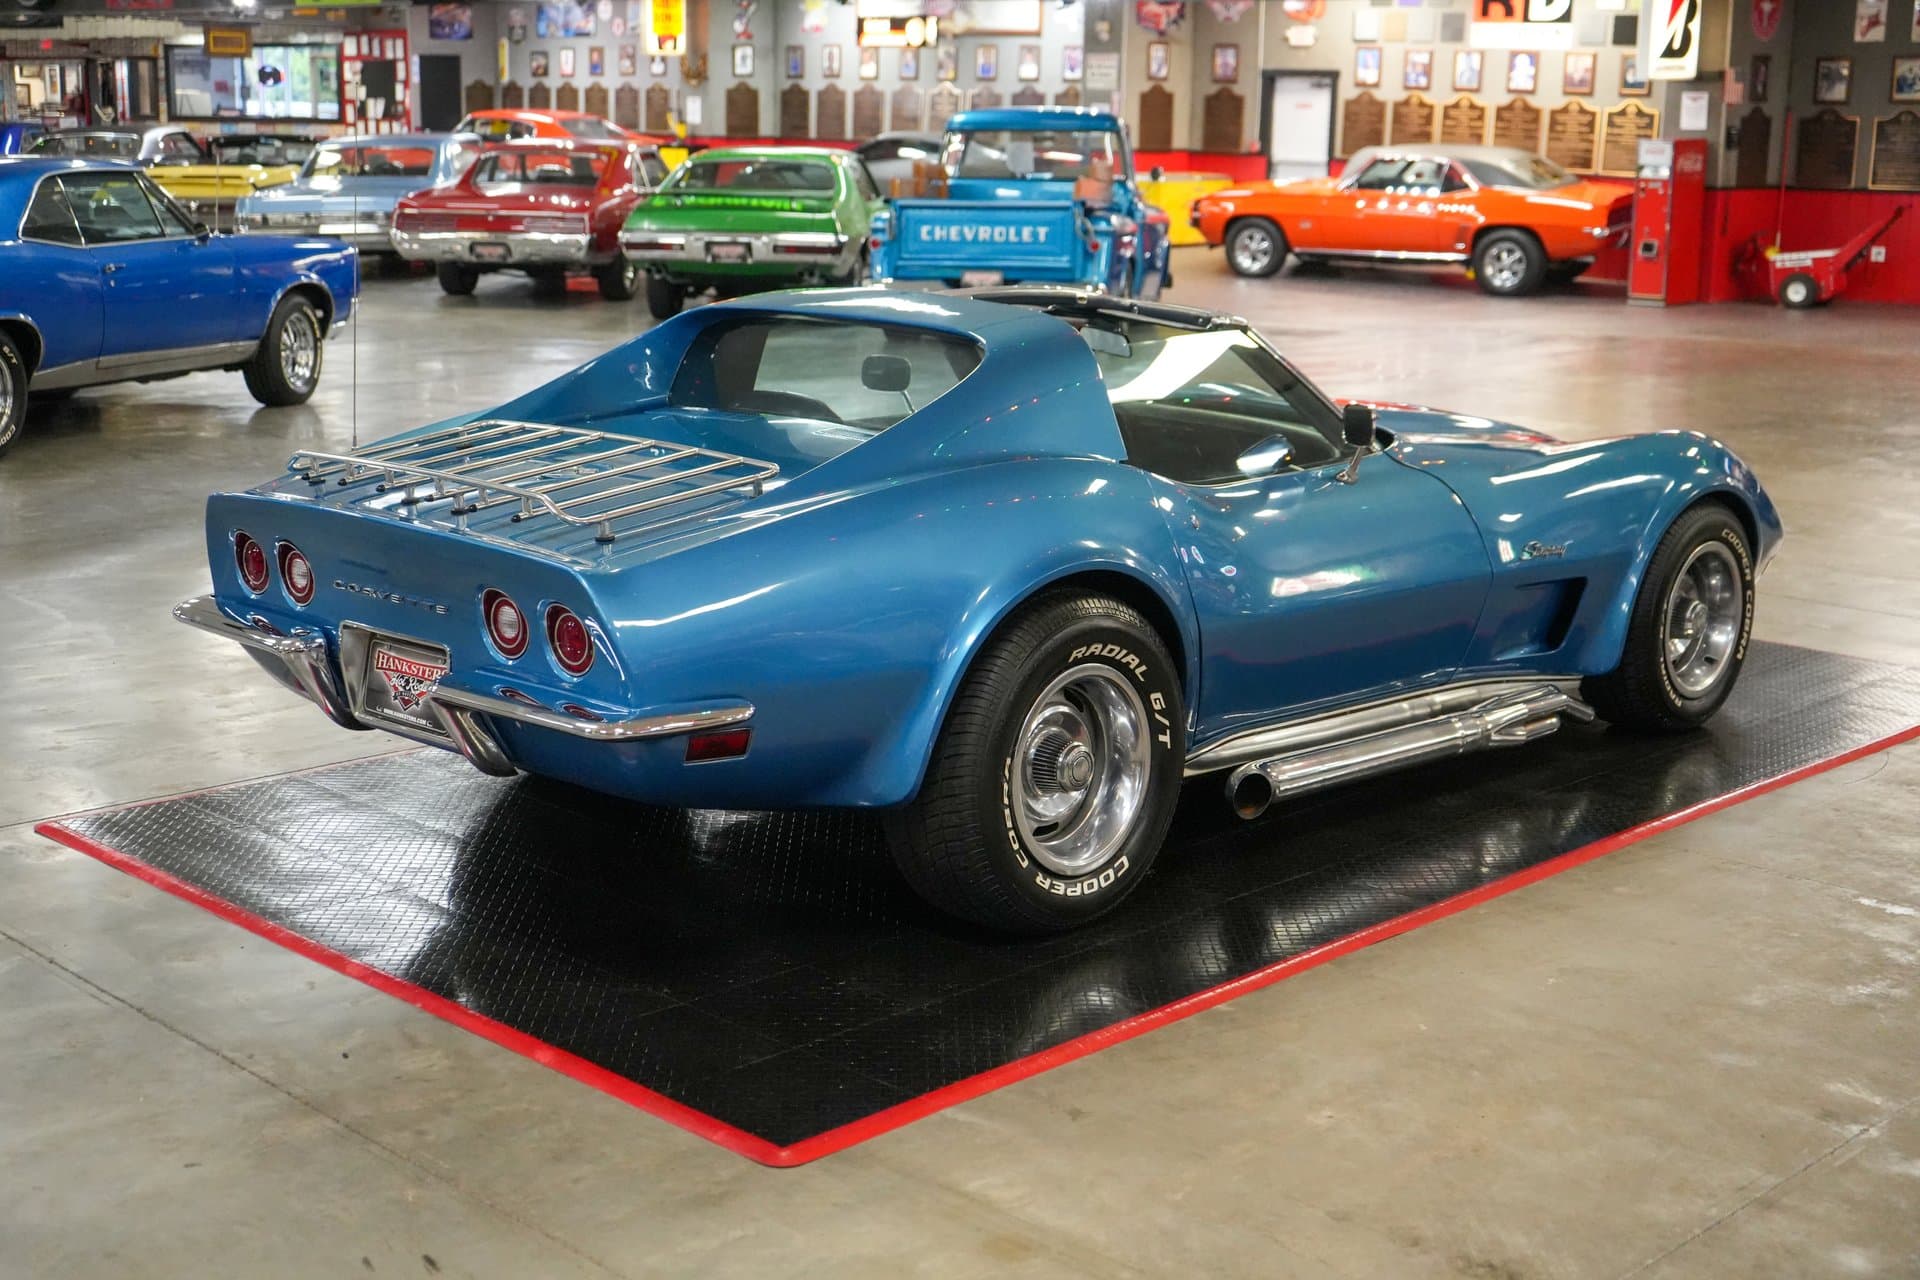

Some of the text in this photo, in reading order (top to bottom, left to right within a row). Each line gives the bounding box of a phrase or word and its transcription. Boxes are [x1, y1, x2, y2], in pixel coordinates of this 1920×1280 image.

[920, 224, 1050, 243] CHEVROLET
[332, 579, 449, 615] CORVETTE
[1721, 528, 1753, 660] COOPER COBRA
[1068, 642, 1173, 750] RADIAL G/T
[1002, 756, 1130, 897] COOPER COBRA
